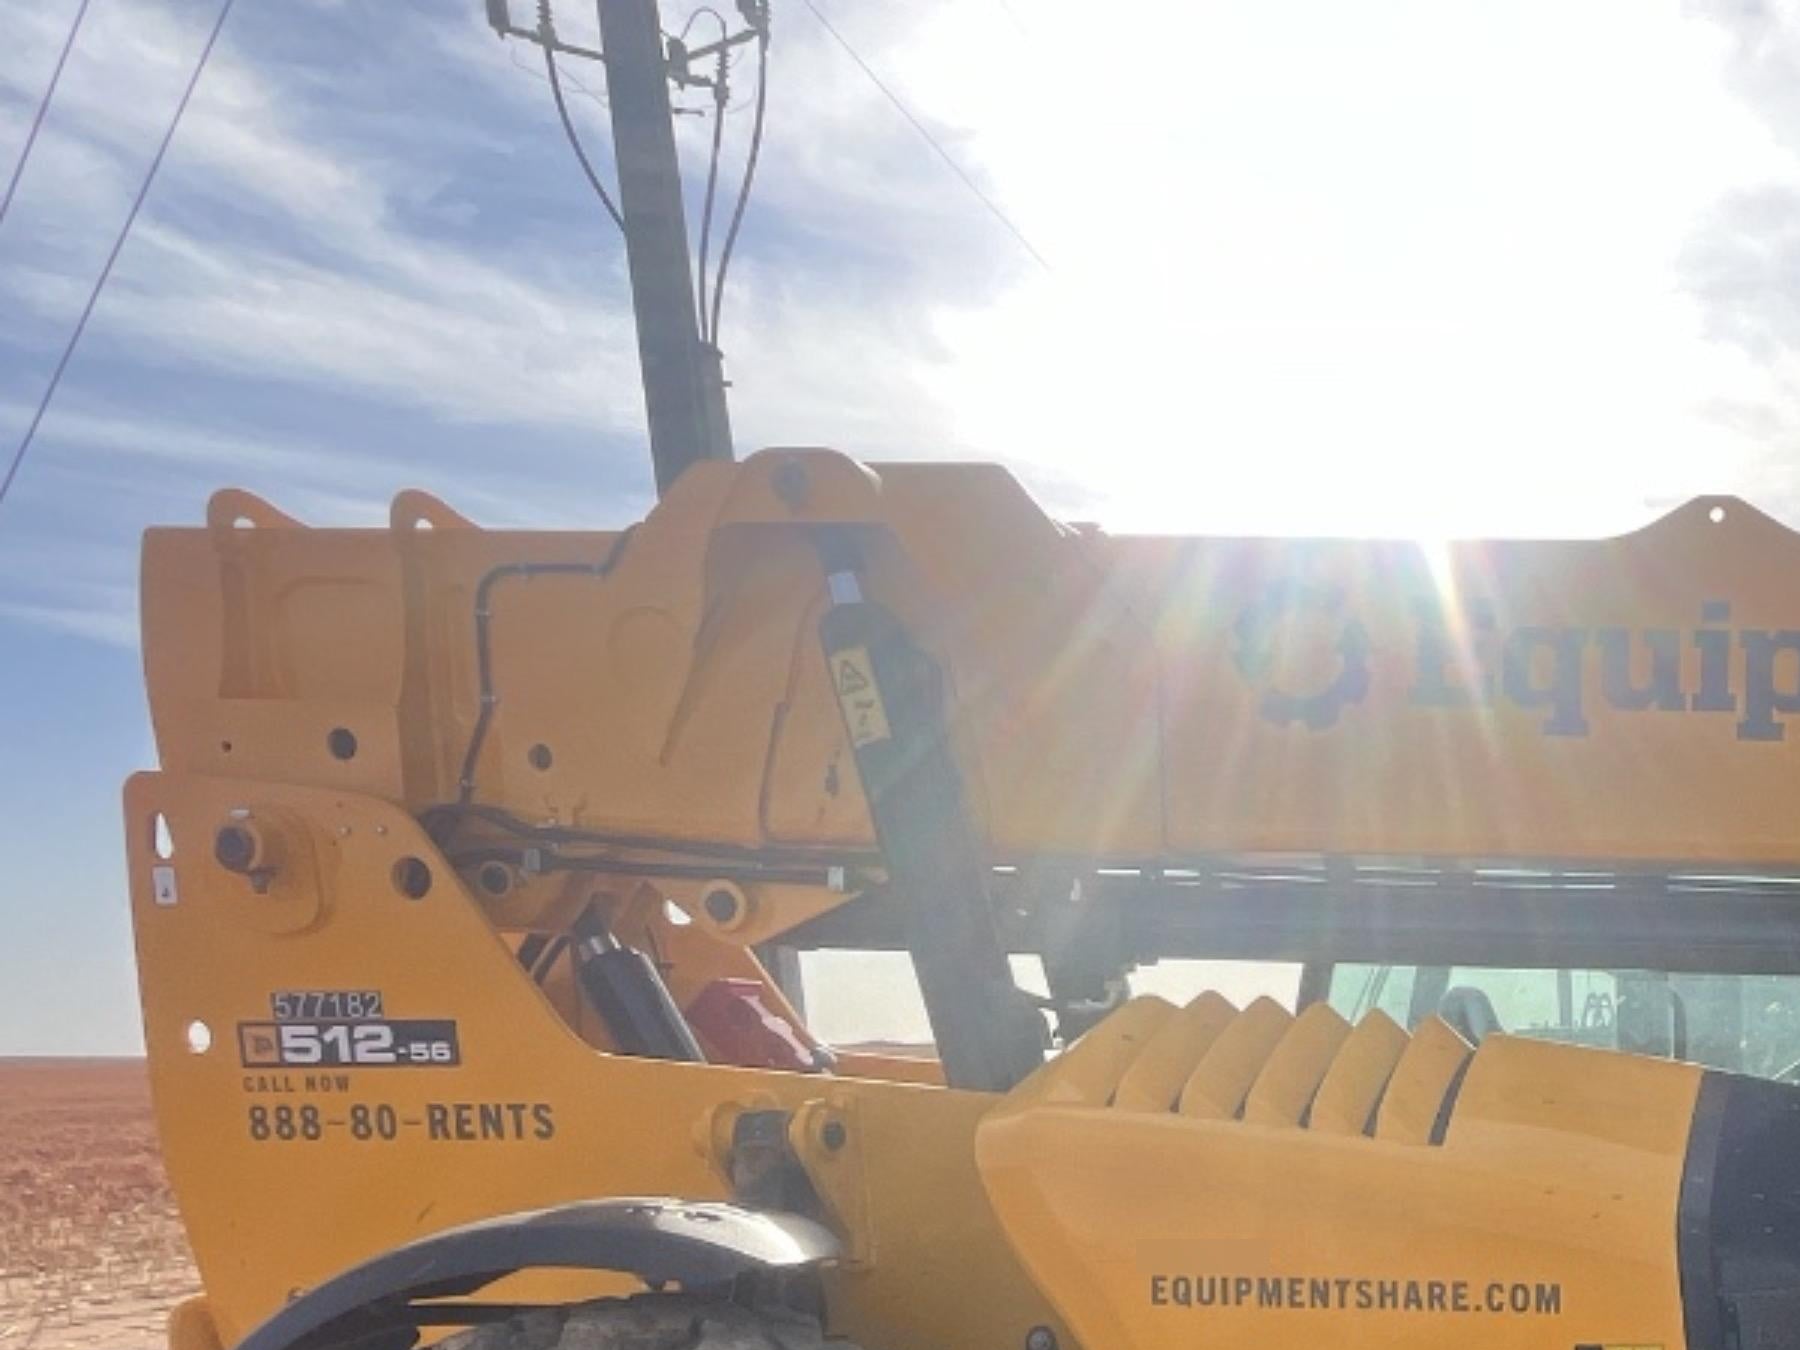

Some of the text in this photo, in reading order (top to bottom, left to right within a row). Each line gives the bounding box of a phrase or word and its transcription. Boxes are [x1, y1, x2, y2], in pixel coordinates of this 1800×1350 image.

[274, 991, 383, 1018] 577182
[243, 1076, 350, 1092] CALL NOW
[249, 1103, 555, 1140] 888-80-RENTS
[1150, 1274, 1562, 1314] EQUIPMENTSHARE.COM
